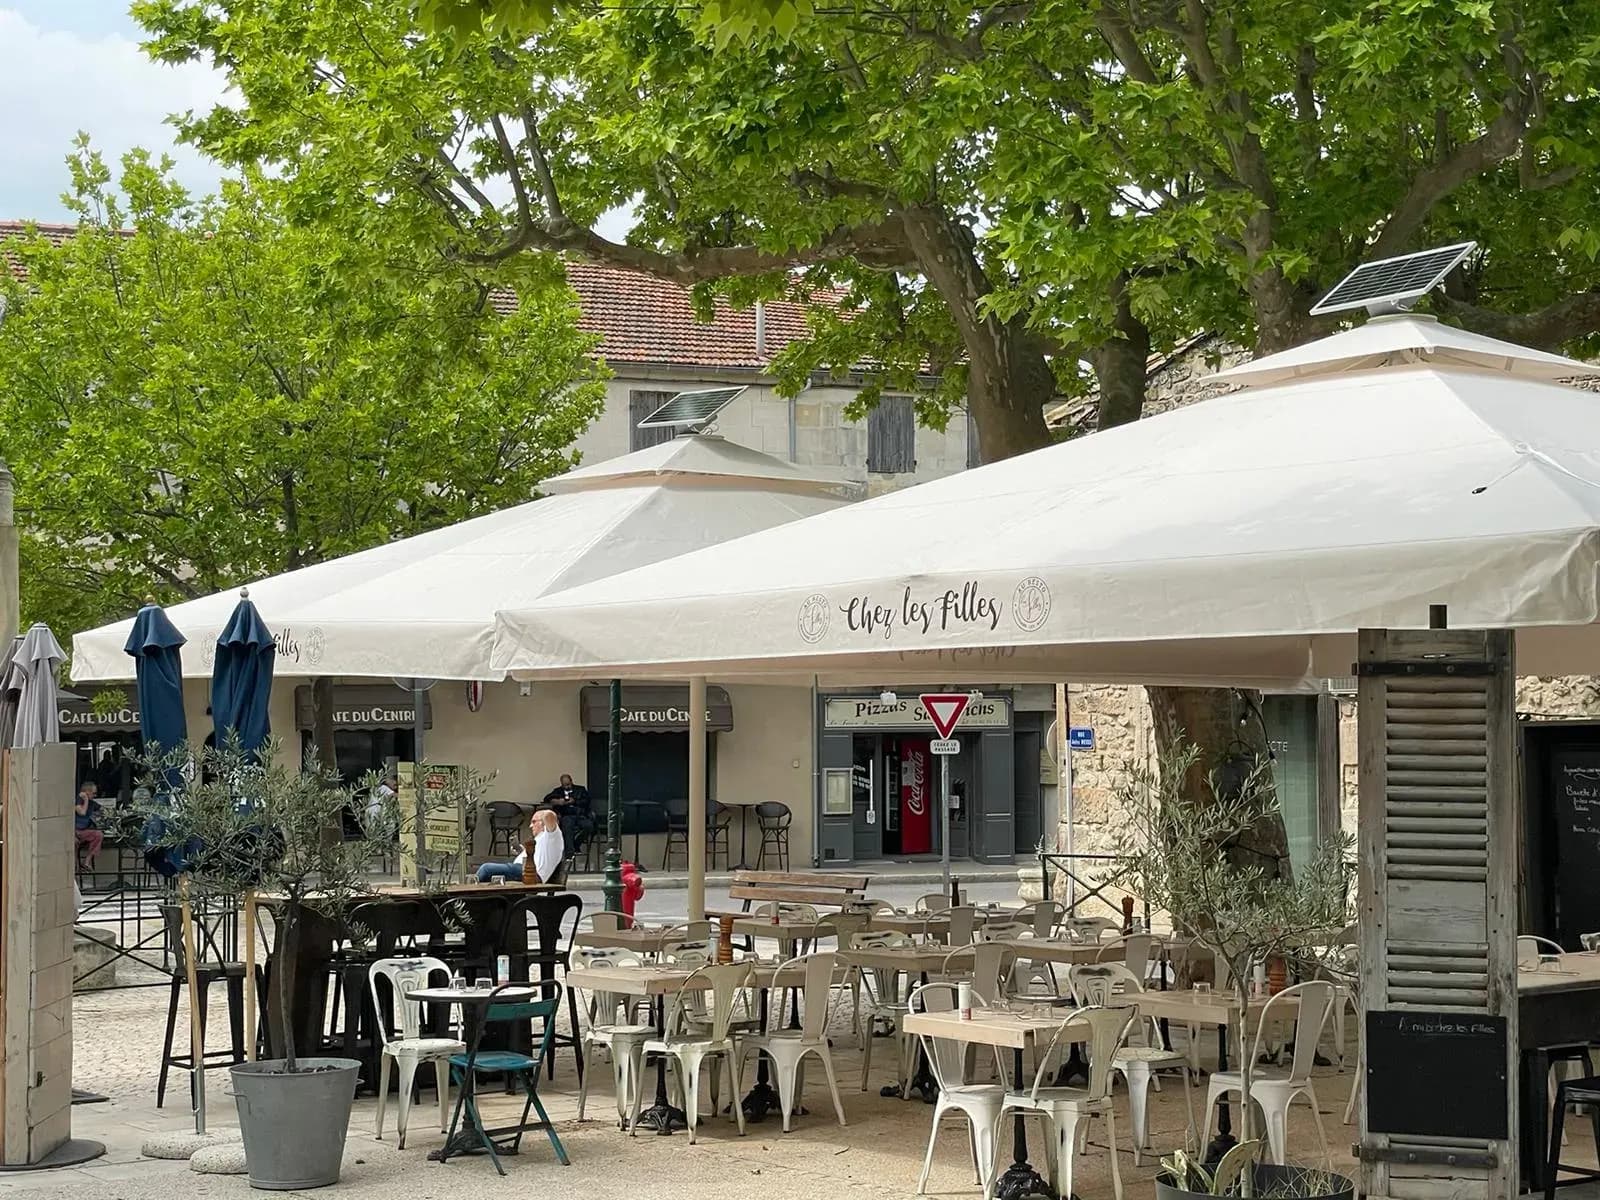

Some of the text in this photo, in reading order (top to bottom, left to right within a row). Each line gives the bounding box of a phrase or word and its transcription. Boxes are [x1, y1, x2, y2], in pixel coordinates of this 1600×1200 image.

[839, 596, 897, 639] Chez
[903, 586, 934, 634] les
[352, 711, 370, 722] DU
[649, 711, 666, 722] DU
[666, 707, 711, 722] CENE
